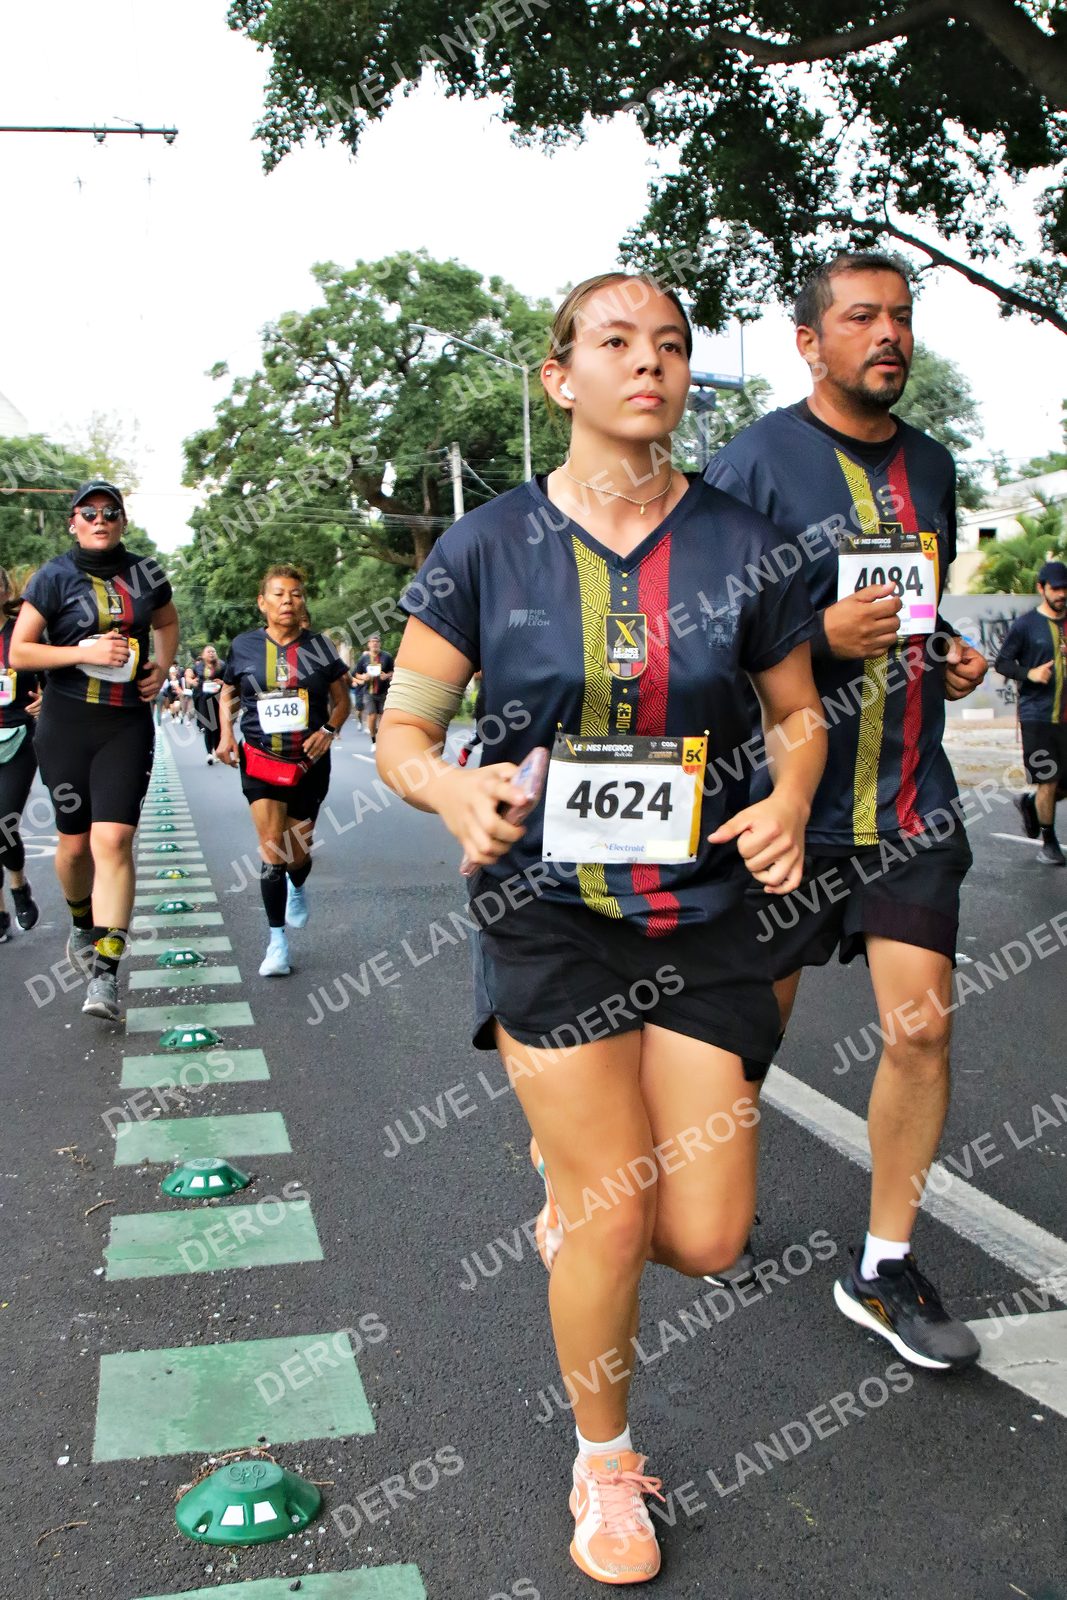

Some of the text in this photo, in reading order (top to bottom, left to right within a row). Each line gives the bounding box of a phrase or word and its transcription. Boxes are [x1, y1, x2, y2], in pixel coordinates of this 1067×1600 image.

[854, 565, 923, 597] 4084
[264, 702, 299, 718] 4548
[573, 743, 602, 752] LENES
[566, 780, 673, 821] 4624
